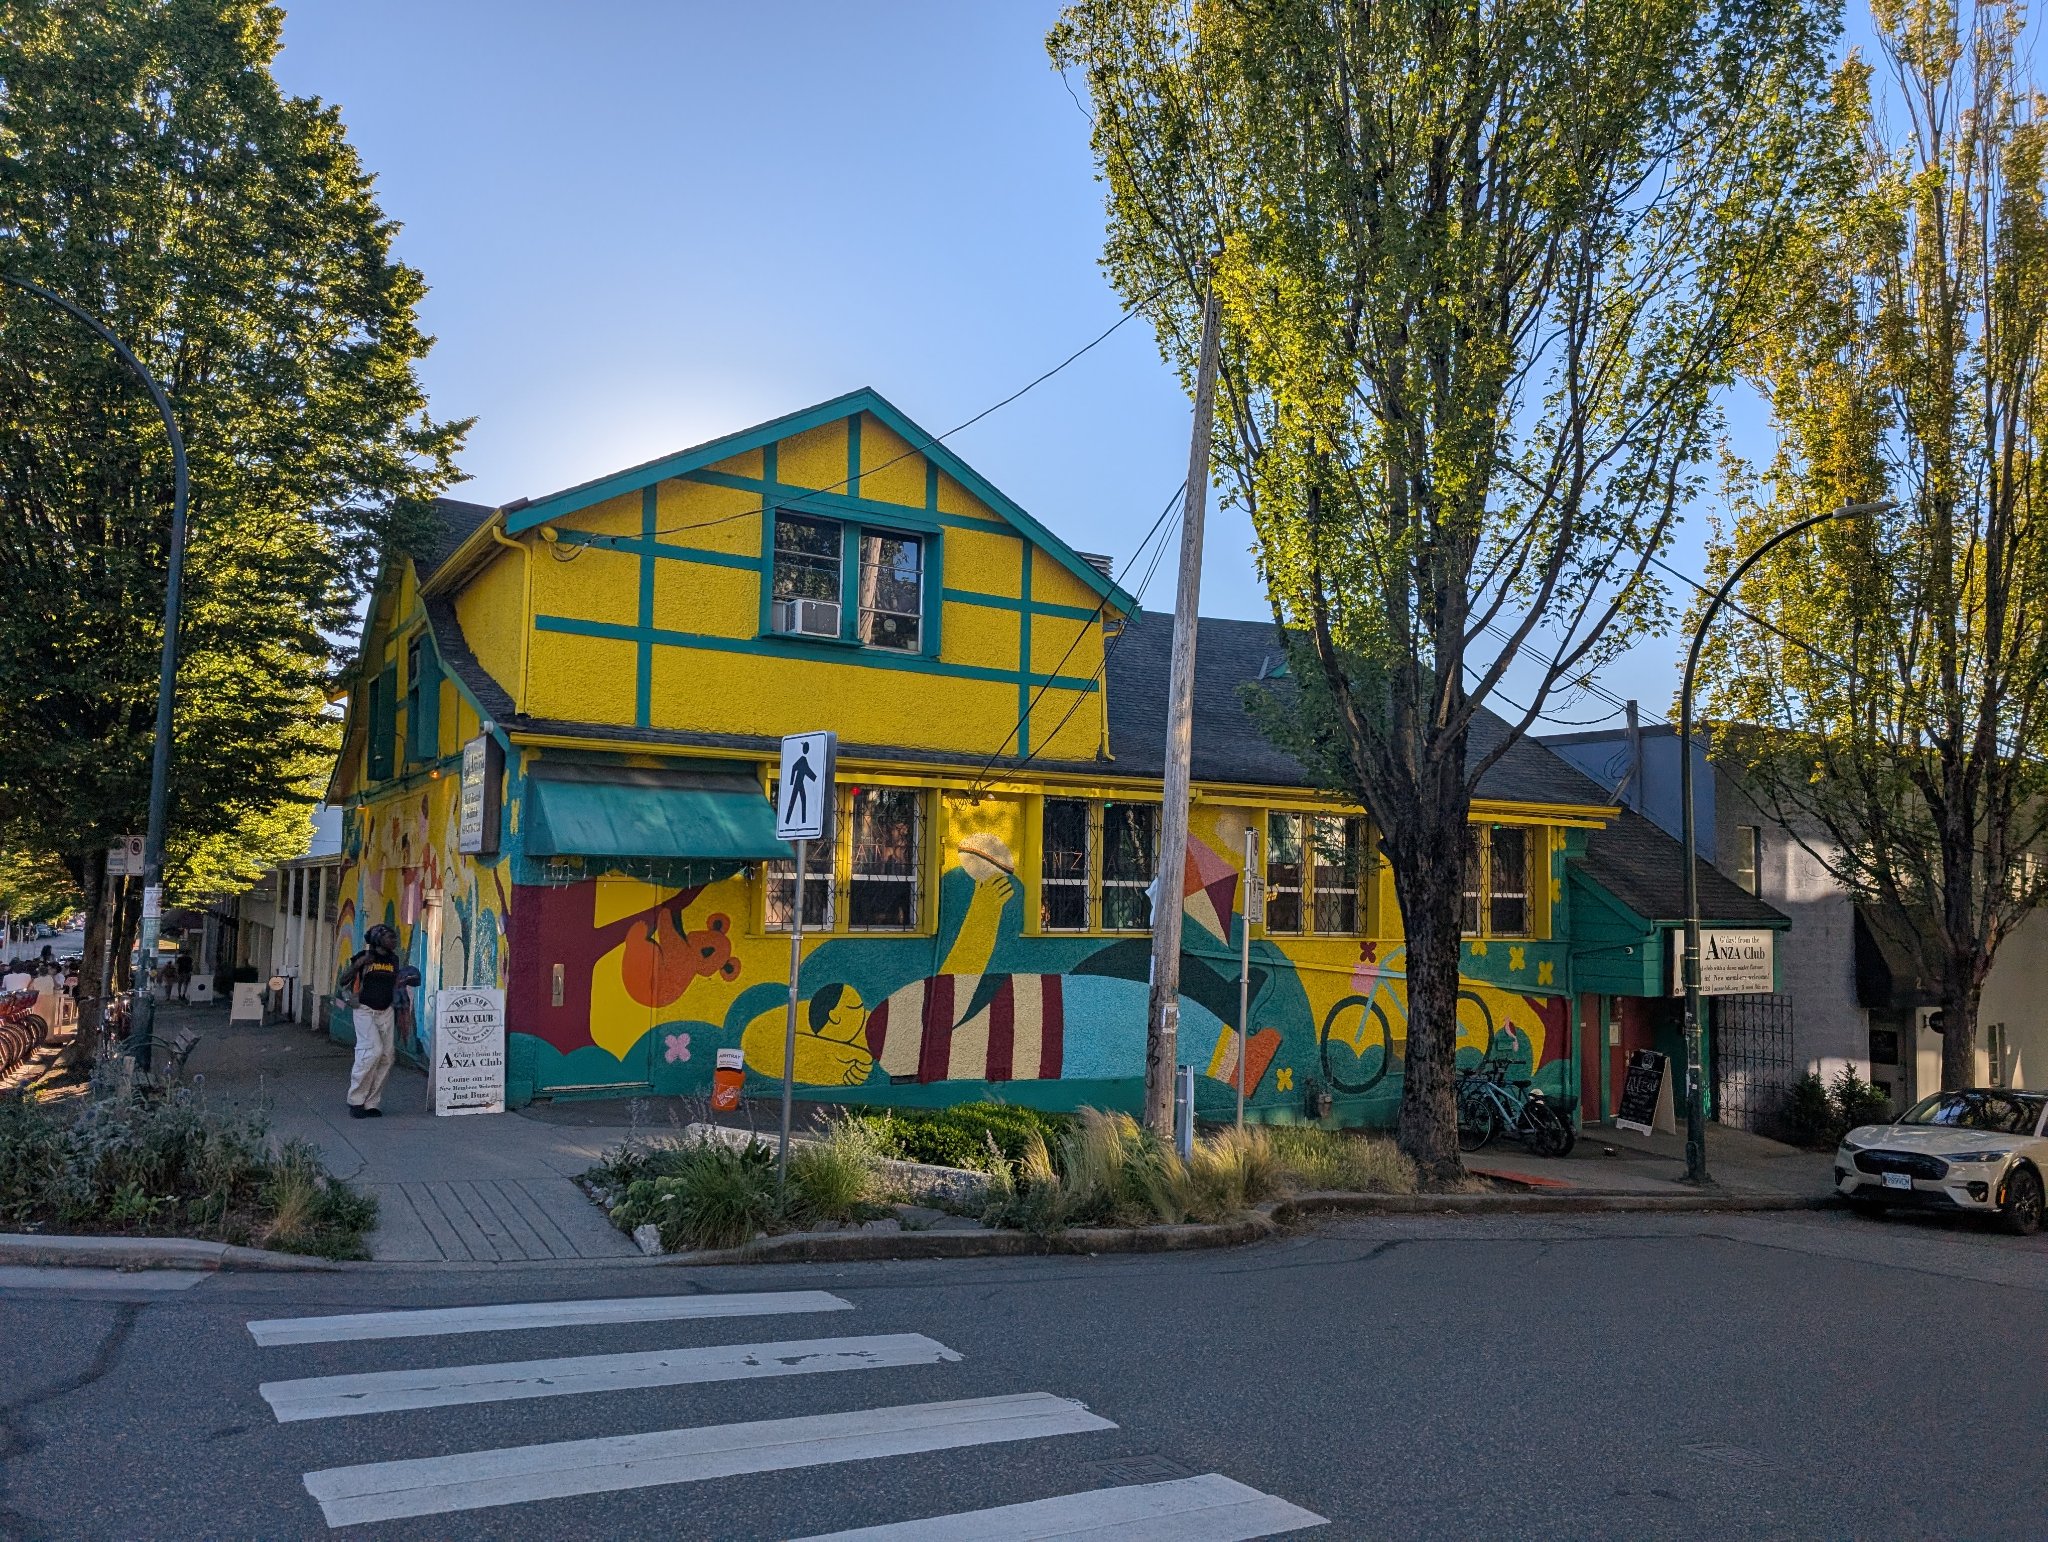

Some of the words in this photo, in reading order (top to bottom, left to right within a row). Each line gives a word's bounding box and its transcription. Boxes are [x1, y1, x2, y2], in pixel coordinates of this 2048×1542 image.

[1738, 936, 1751, 944] from
[1752, 935, 1760, 943] the
[1705, 934, 1740, 960] ANZA
[1744, 947, 1765, 960] Club
[454, 996, 472, 1008] HOME
[449, 1014, 470, 1024] ANZA
[473, 1014, 494, 1023] CLUB
[439, 1052, 476, 1069] ANZA
[480, 1058, 502, 1067] Club
[447, 1076, 470, 1084] Come
[452, 1092, 468, 1101] Just
